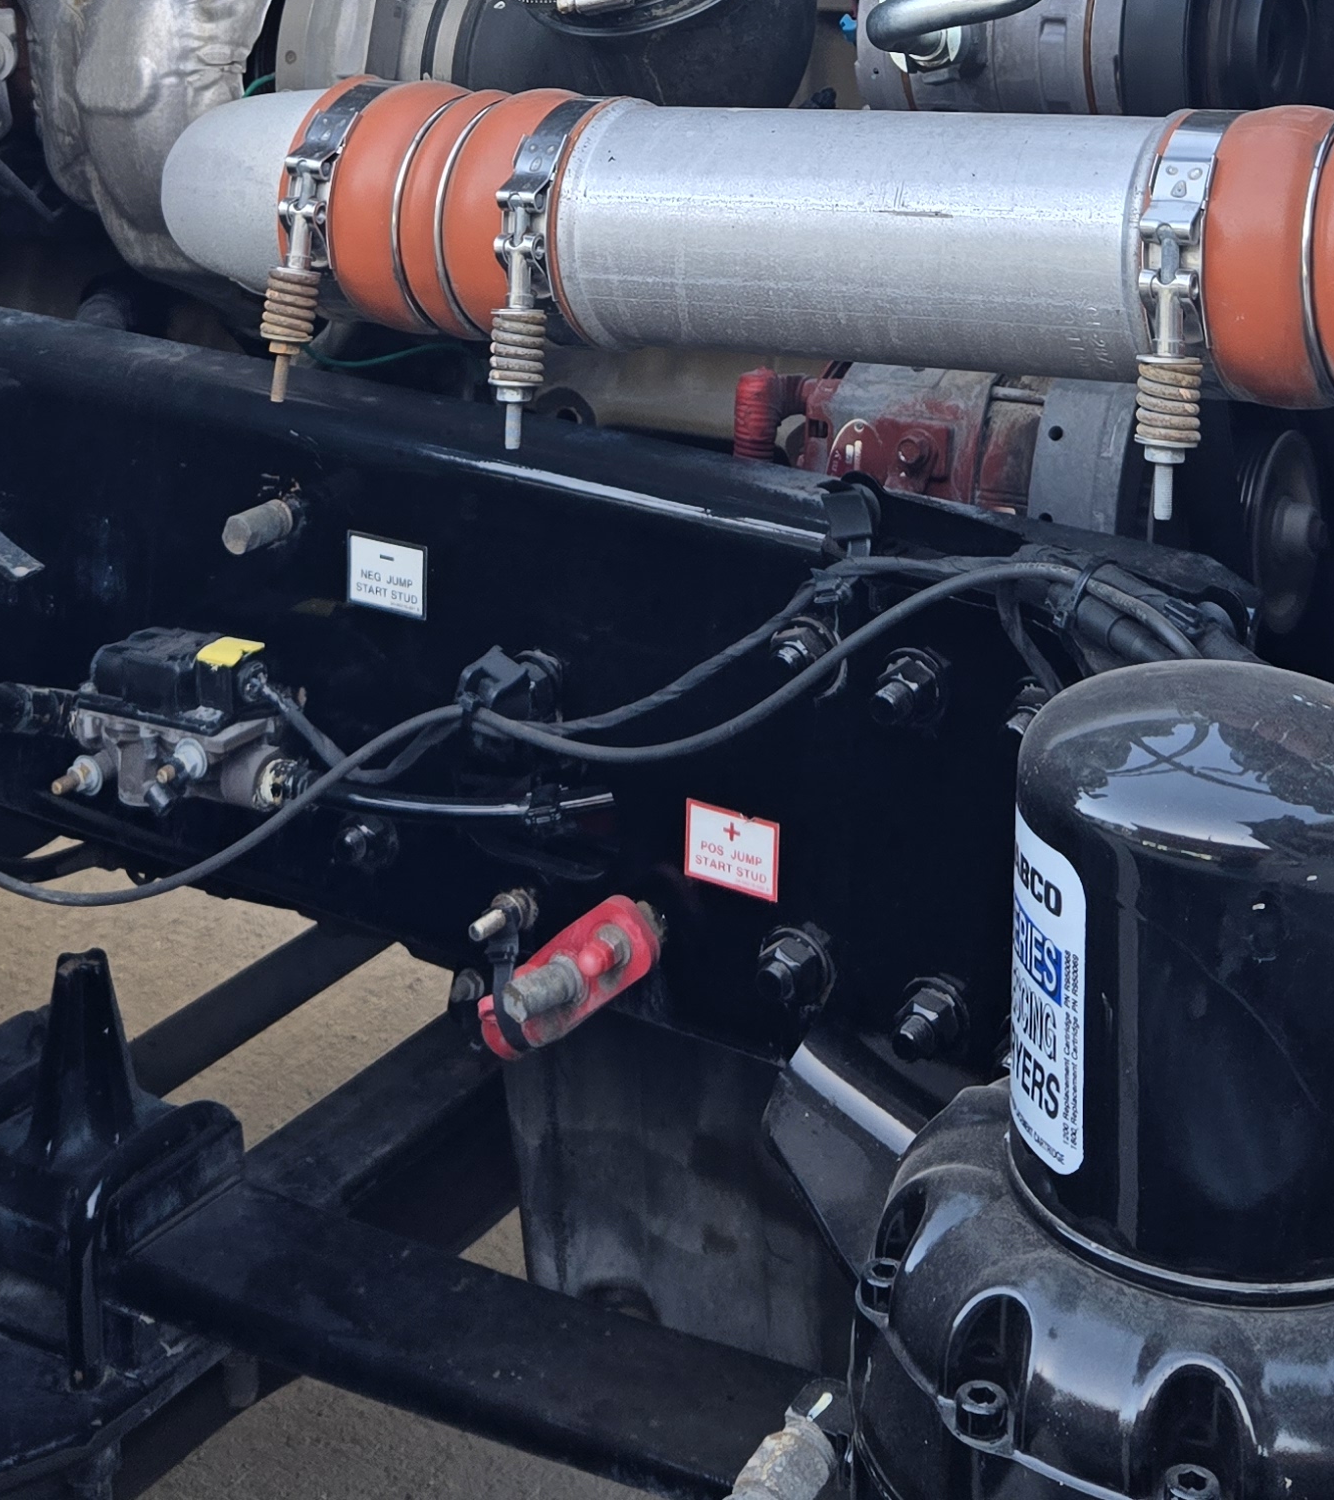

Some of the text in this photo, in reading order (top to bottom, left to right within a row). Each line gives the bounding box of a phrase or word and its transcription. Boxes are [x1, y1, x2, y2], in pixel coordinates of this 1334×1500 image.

[360, 568, 413, 589] NEG JUMP
[356, 581, 418, 605] START STUD
[700, 840, 763, 866] POS JUMP
[695, 854, 767, 884] START STUD
[1064, 995, 1071, 1009] PN
[1072, 999, 1079, 1013] PN
[1063, 1011, 1072, 1056] Cartridge
[1071, 1016, 1079, 1061] Cartridge
[1062, 1057, 1071, 1121] Replacement
[1070, 1062, 1079, 1126] Replacement
